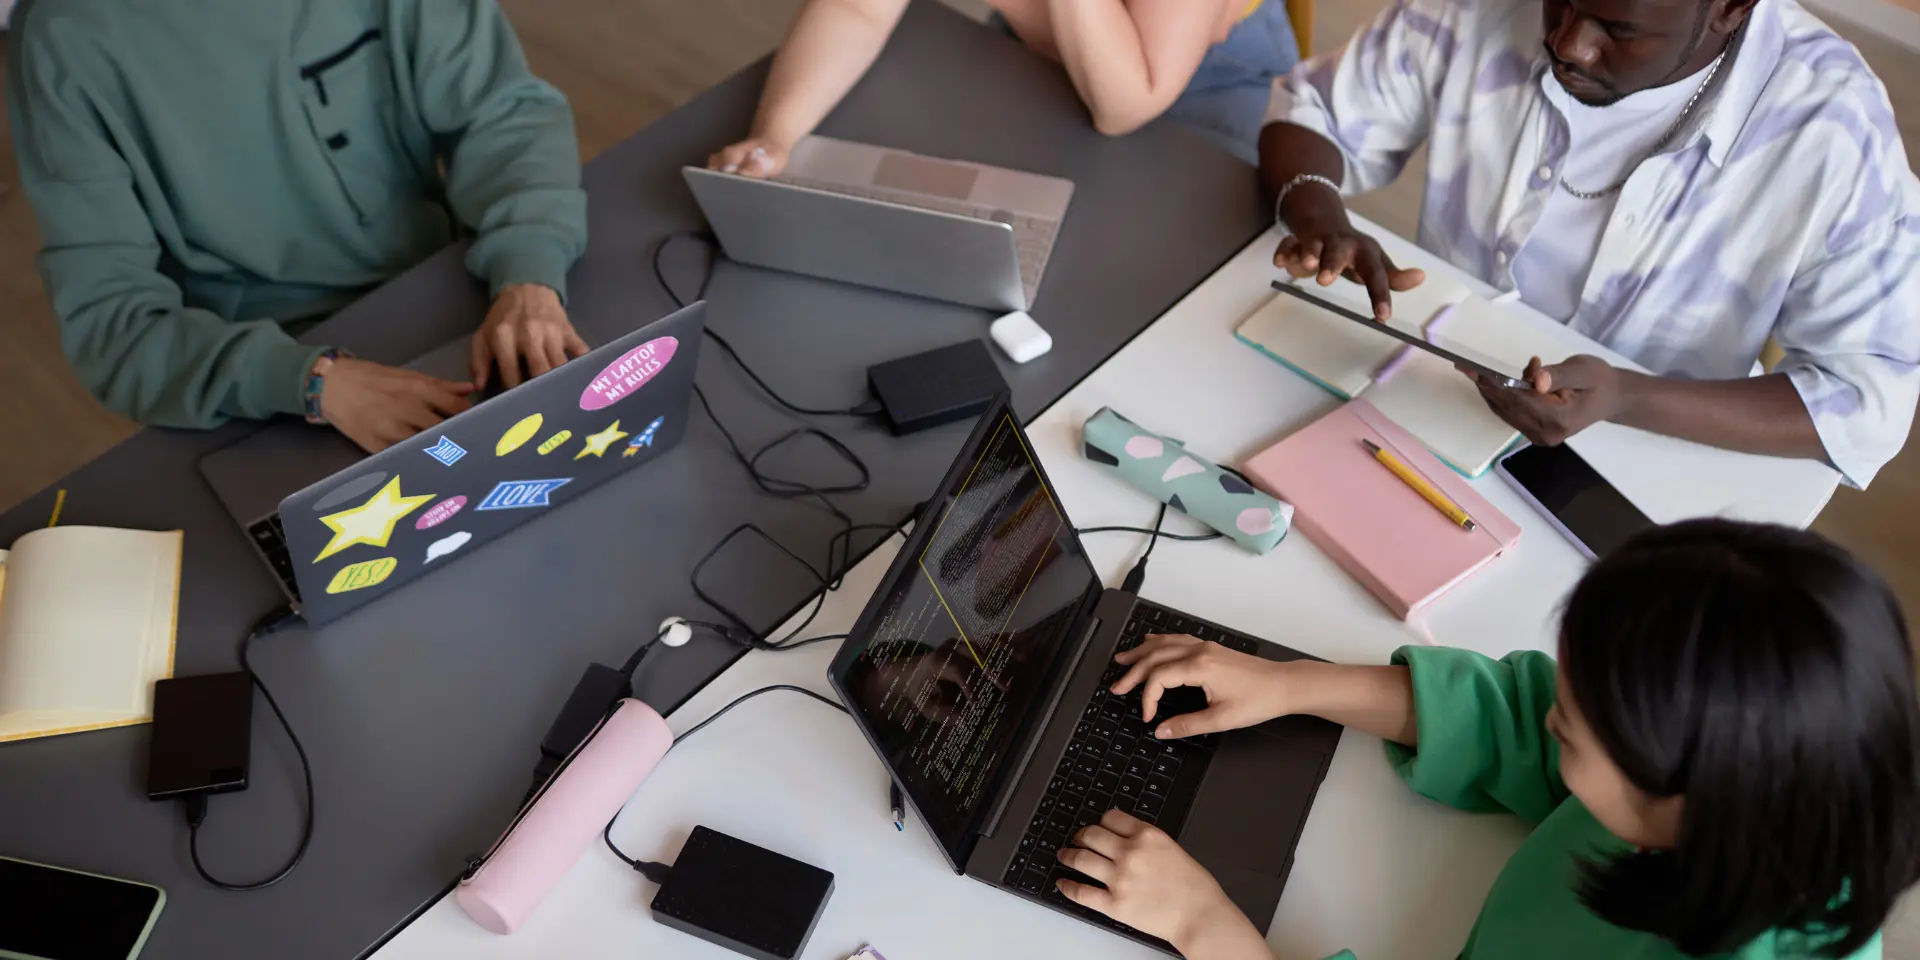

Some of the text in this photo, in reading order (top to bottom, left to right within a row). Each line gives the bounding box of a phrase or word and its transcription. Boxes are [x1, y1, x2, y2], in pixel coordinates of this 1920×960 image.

[592, 344, 655, 393] MY LAPTOP
[605, 358, 661, 400] MY RULES
[492, 484, 550, 505] LOVE
[341, 560, 390, 588] YES!
